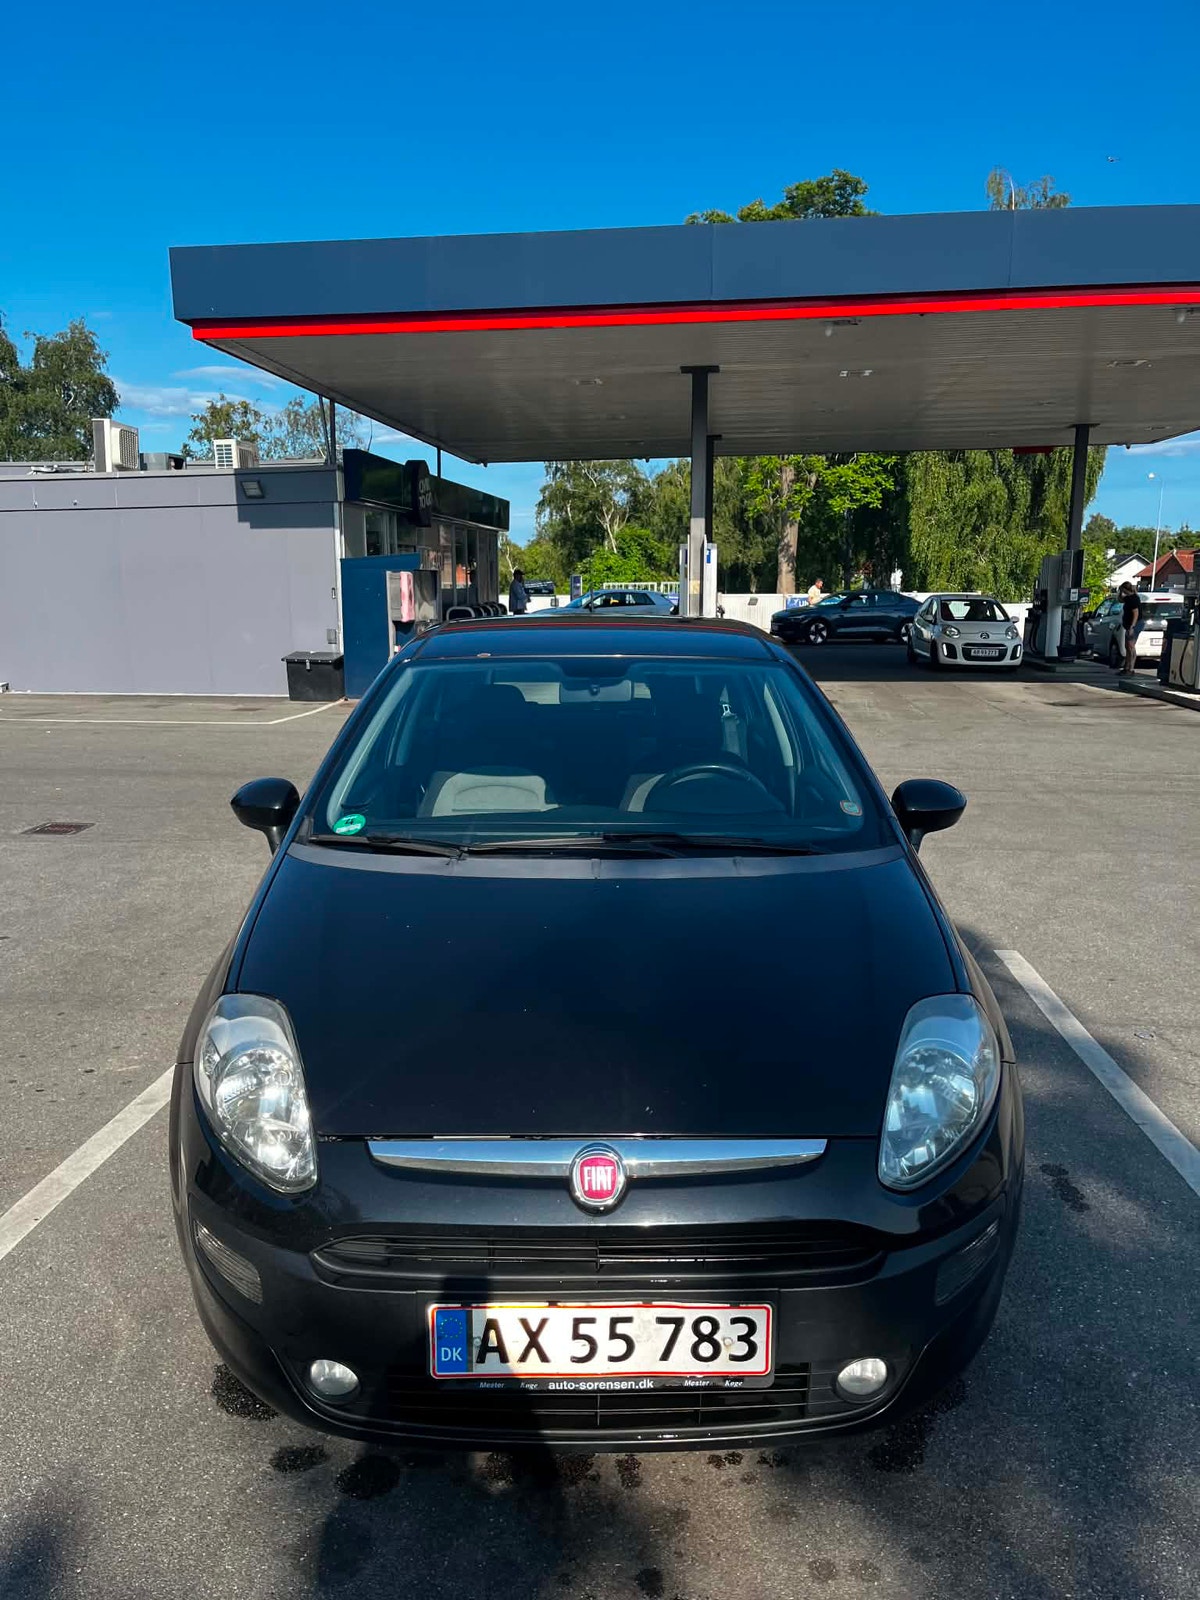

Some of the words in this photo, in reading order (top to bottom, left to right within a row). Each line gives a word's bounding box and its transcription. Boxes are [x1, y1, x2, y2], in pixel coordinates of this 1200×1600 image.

[583, 1165, 614, 1191] FIAT
[475, 1317, 550, 1364] AX
[570, 1316, 636, 1364] 55
[655, 1315, 759, 1363] 783
[441, 1347, 462, 1361] DK
[548, 1378, 654, 1390] auto-sorensen.dk
